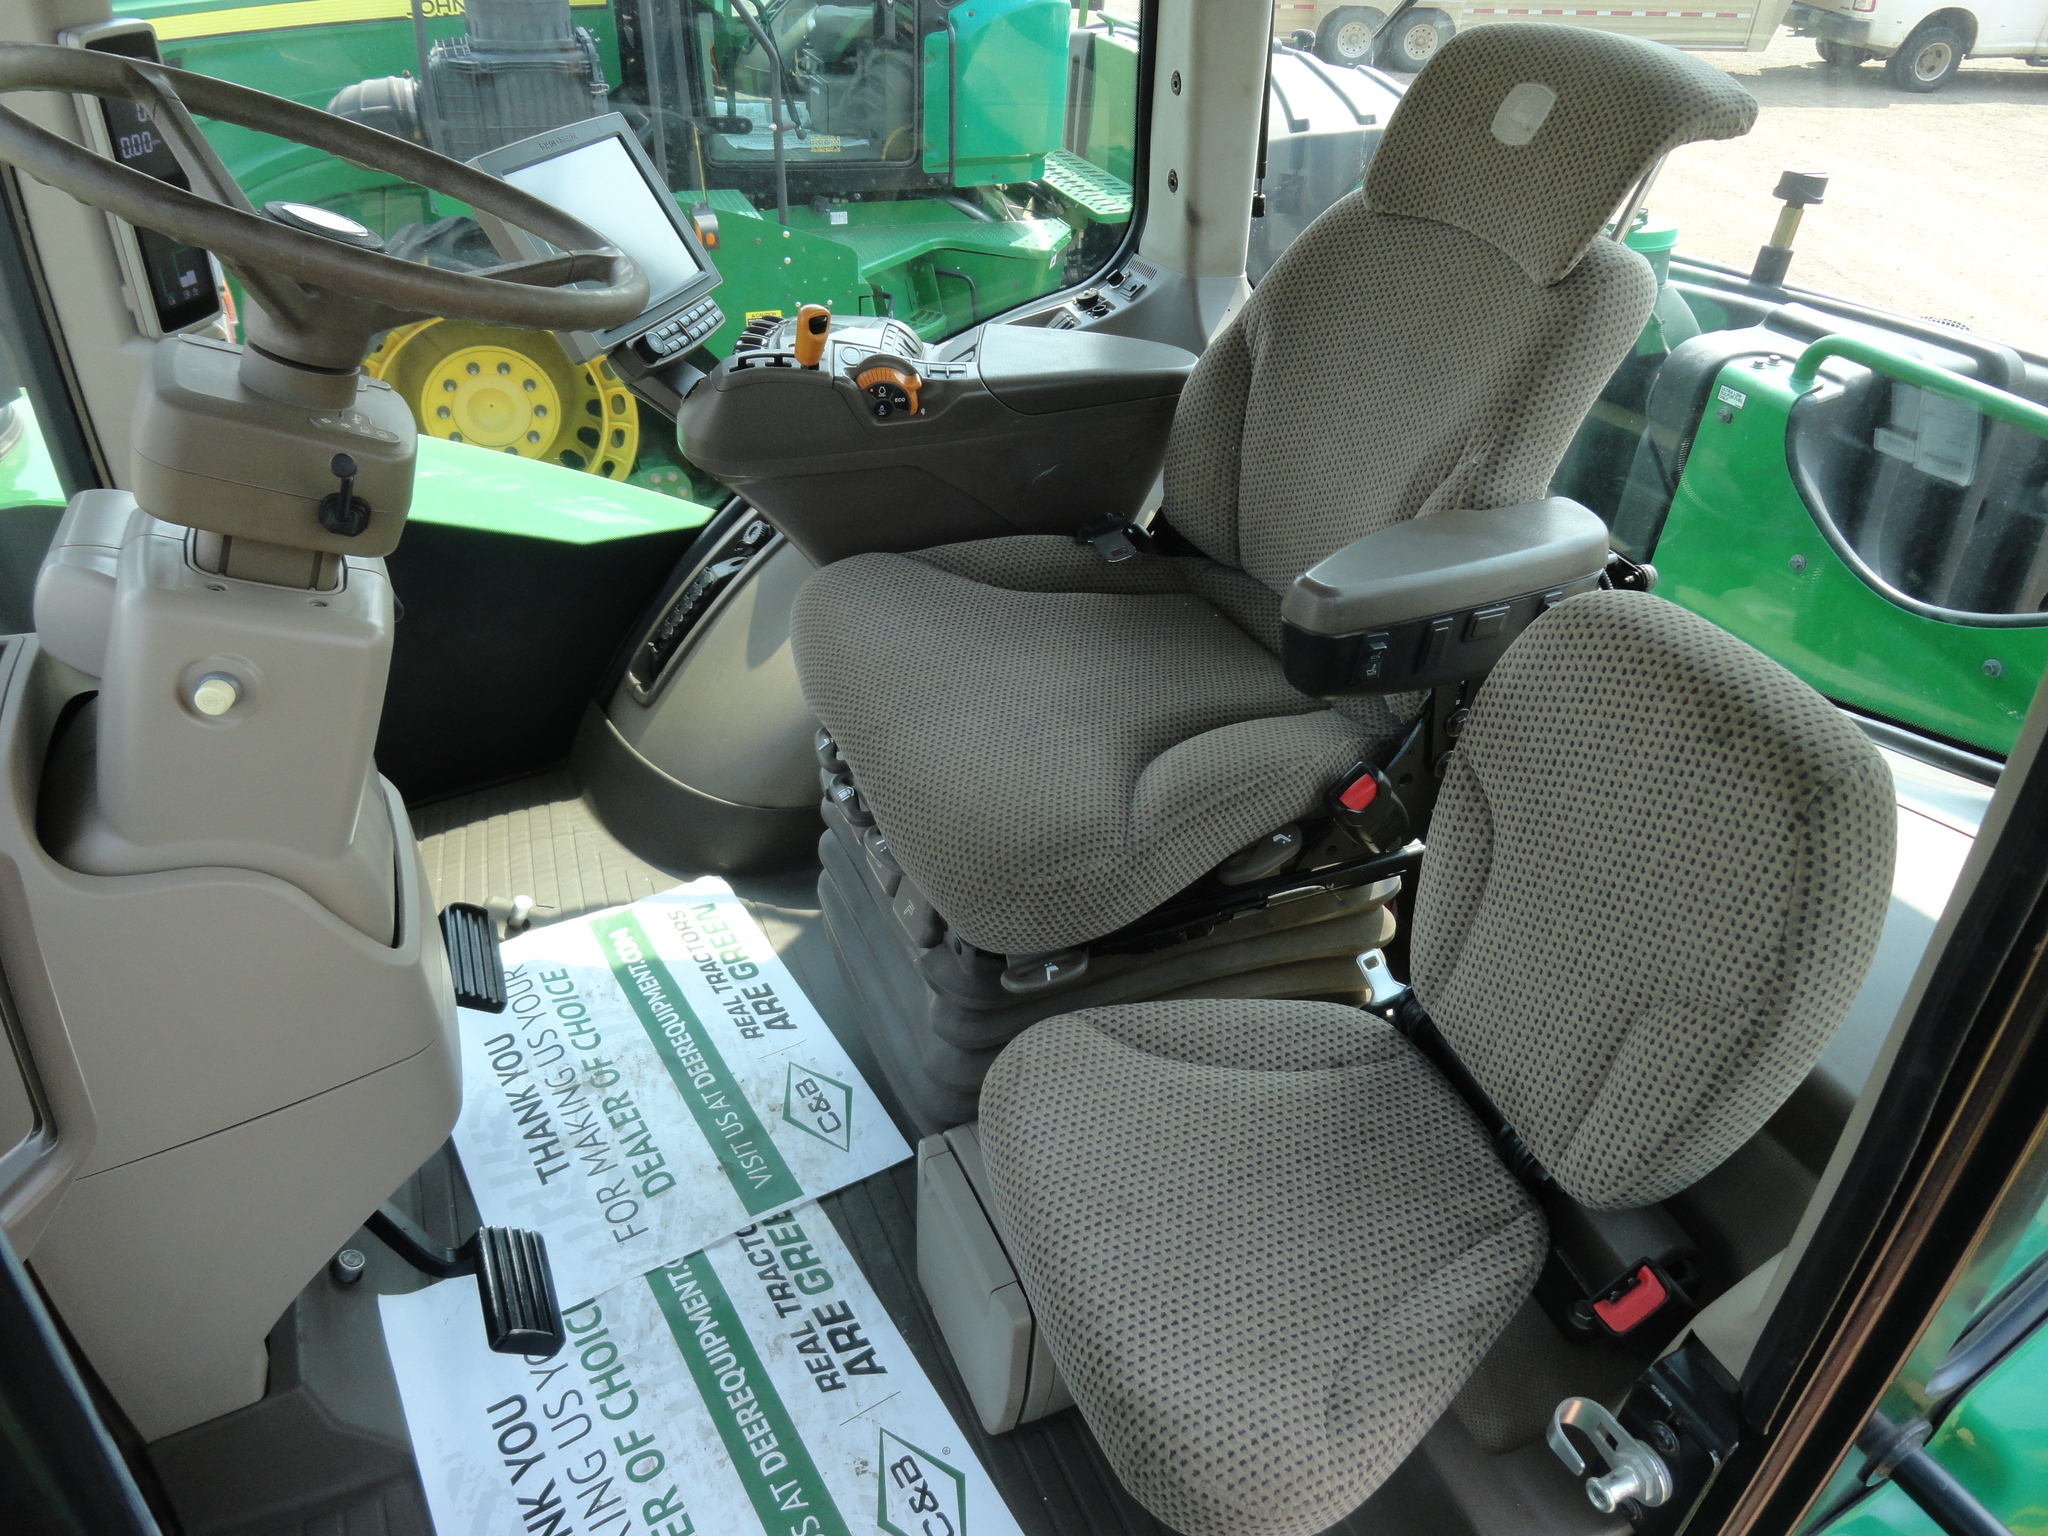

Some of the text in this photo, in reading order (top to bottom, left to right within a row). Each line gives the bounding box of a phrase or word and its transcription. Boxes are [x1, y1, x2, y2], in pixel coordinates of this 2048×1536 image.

[407, 0, 466, 18] OHN
[668, 910, 765, 1039] REAL TRACTORS
[690, 902, 798, 1030] ARE GREEN
[539, 968, 677, 1199] DEALER OF CHOICE
[608, 927, 773, 1190] VISIT US AT DEEREQUIPMENT.COM
[484, 1033, 570, 1186] THANK YOU
[503, 964, 650, 1243] FOR MAKING US YOUR
[795, 1077, 842, 1134] C&B
[664, 1256, 789, 1478] DEEREQUIPMENT.
[790, 1320, 847, 1393] REAL
[812, 1300, 889, 1376] ARE
[486, 1394, 547, 1486] YOU
[543, 1389, 592, 1450] US
[613, 1430, 666, 1484] OF
[567, 1449, 632, 1536] ING
[770, 1479, 809, 1512] AT
[890, 1454, 955, 1536] C&B
